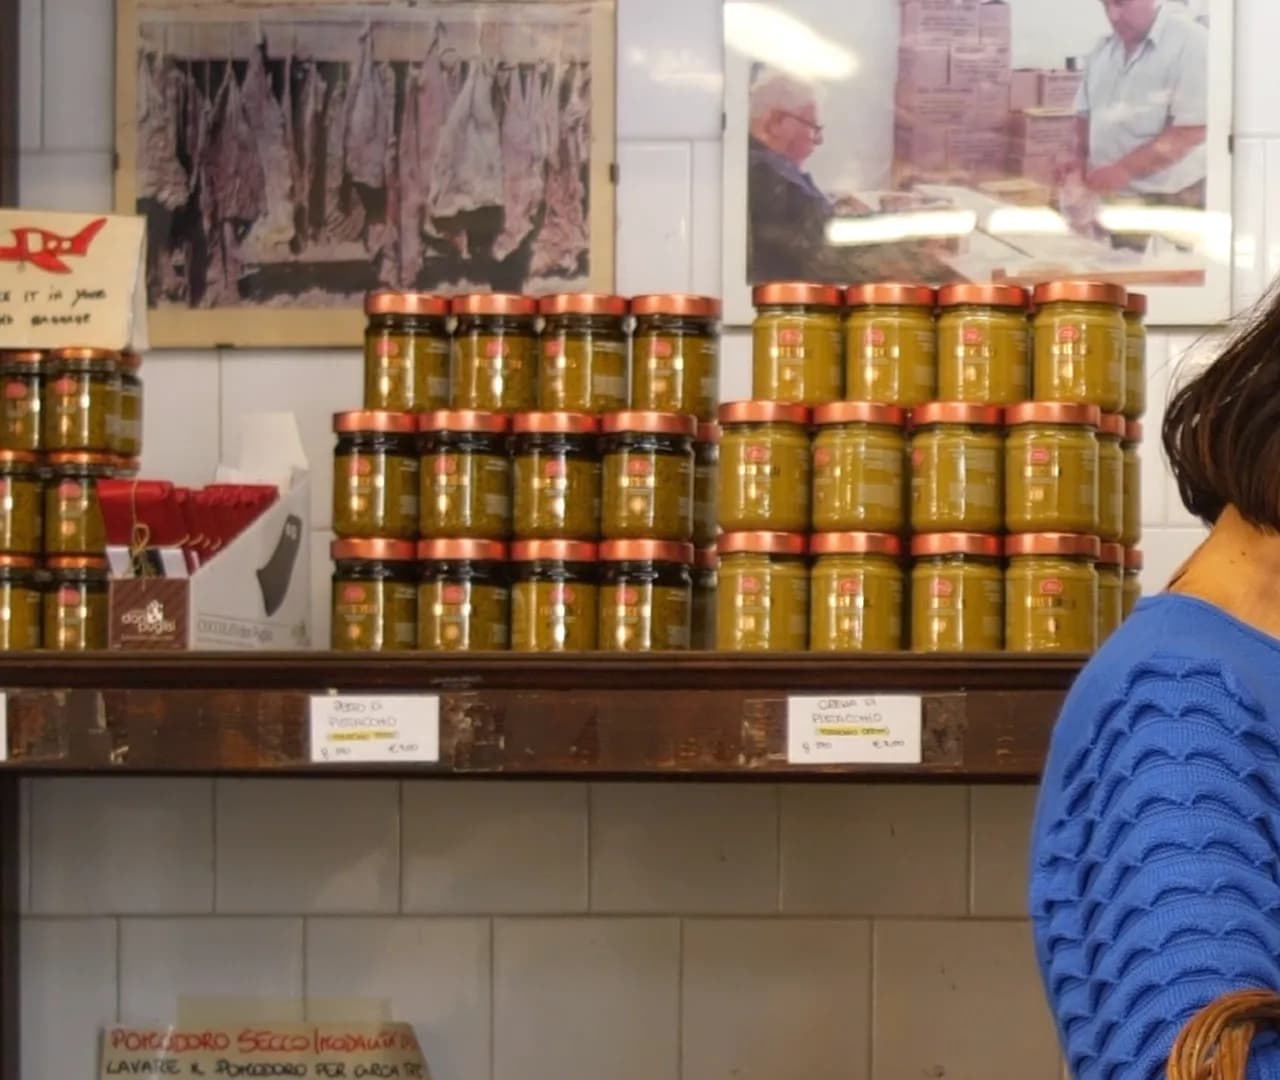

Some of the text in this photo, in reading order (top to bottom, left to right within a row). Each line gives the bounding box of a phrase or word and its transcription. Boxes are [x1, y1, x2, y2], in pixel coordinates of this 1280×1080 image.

[237, 1030, 309, 1052] SECCO
[216, 1059, 307, 1077] POMODORO
[315, 1061, 346, 1078] PER
